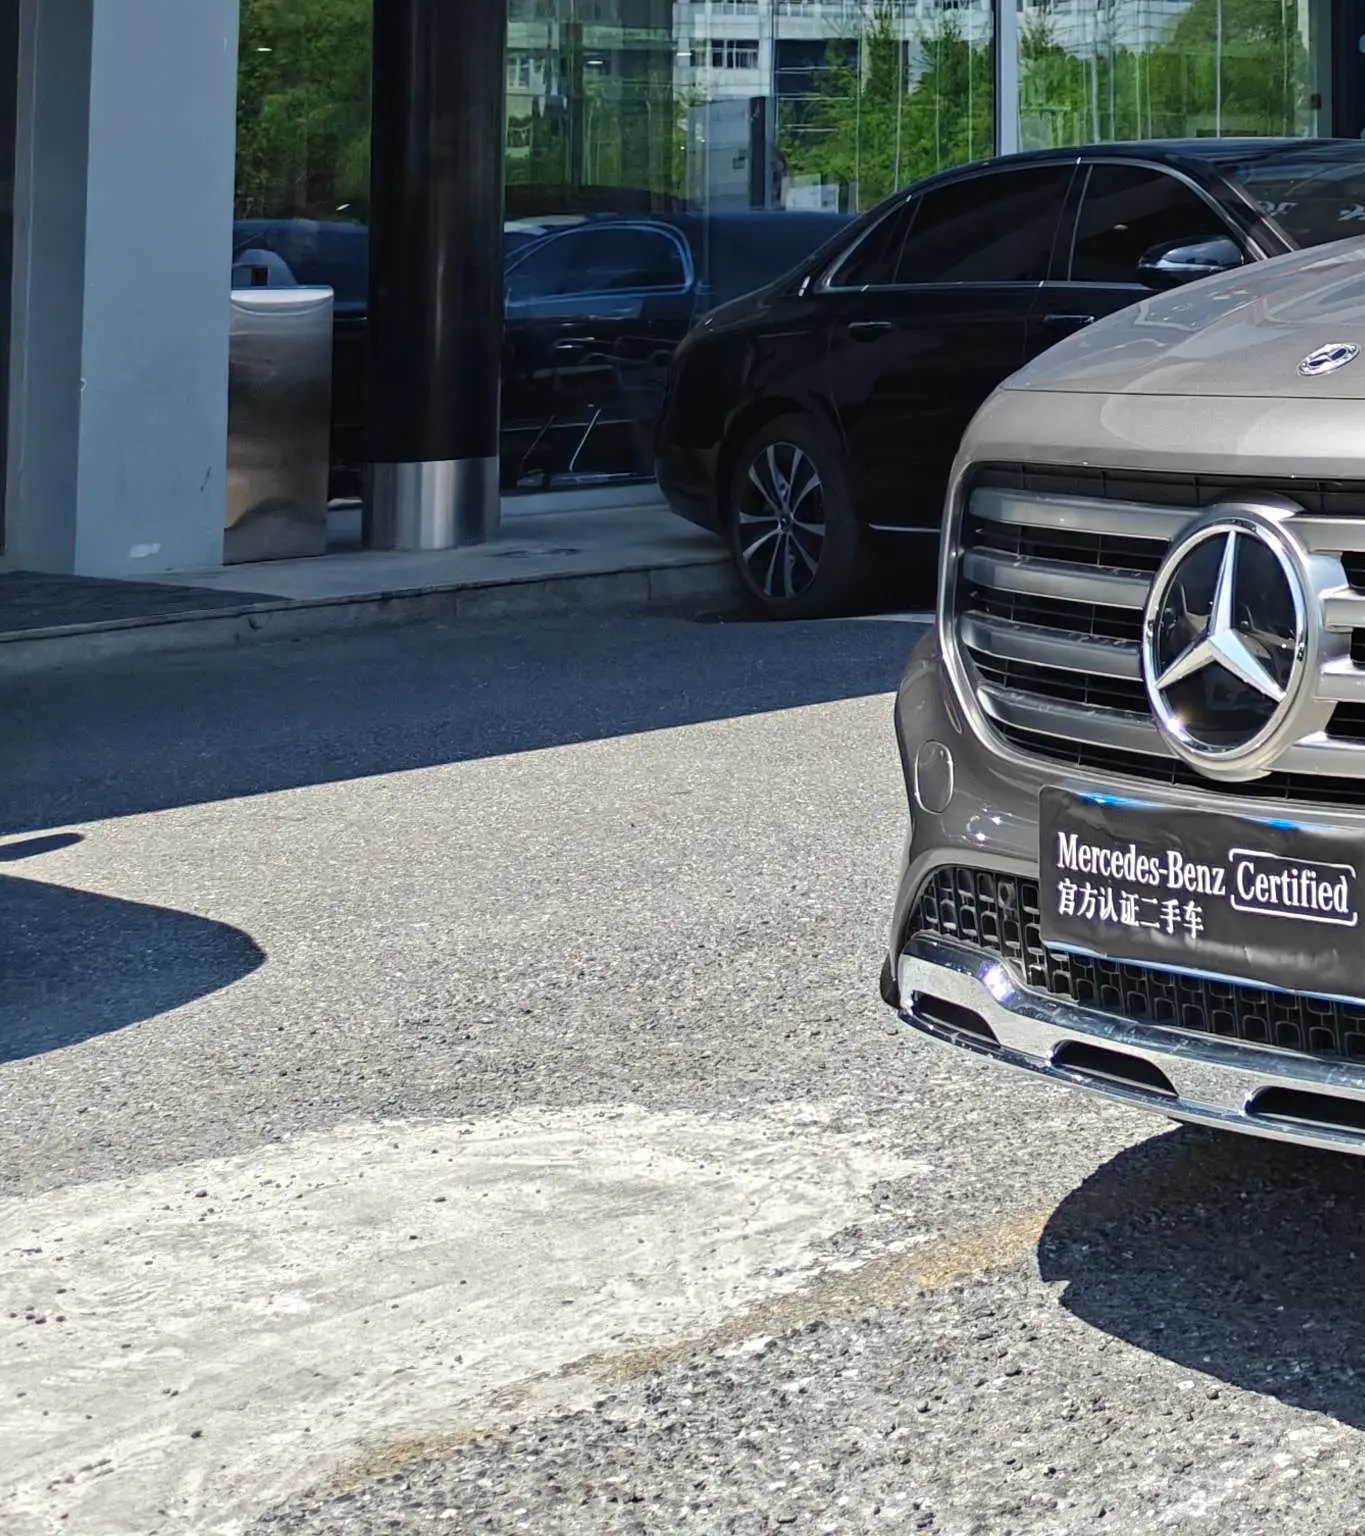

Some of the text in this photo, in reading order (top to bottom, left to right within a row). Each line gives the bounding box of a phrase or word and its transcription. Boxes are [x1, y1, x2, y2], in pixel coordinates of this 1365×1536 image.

[1056, 830, 1350, 915] Mercedes-Benz Certified
[1056, 877, 1205, 940] 官方认证二手车
